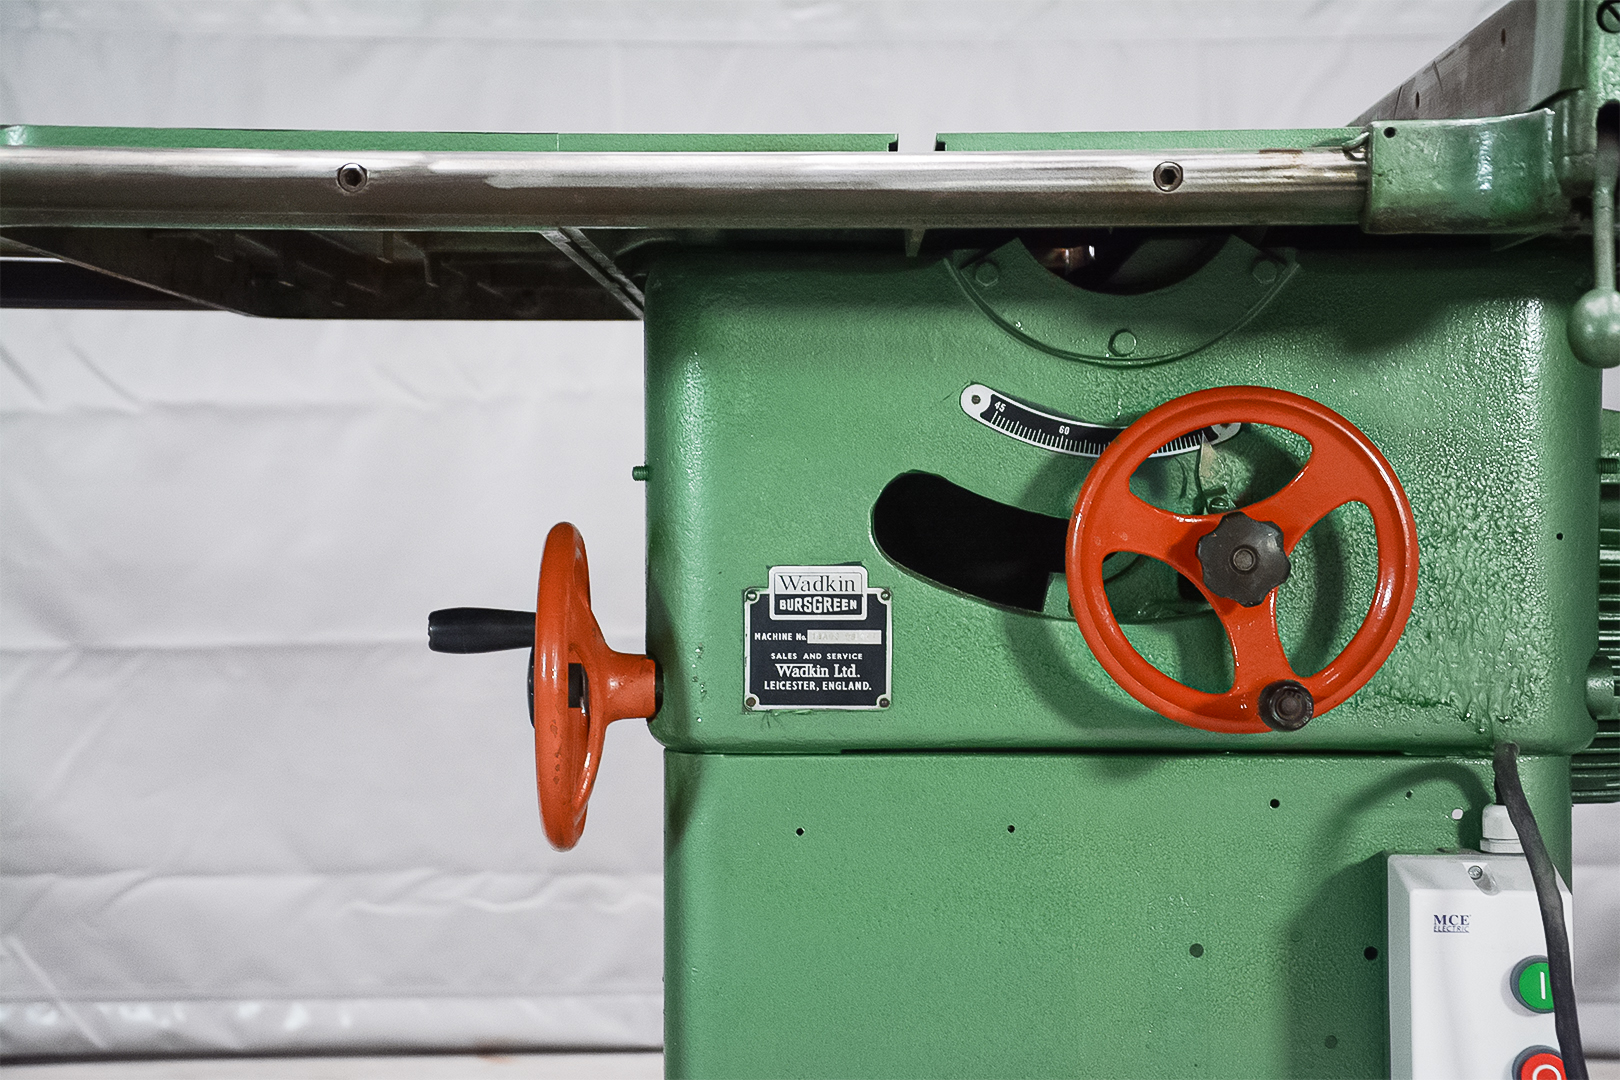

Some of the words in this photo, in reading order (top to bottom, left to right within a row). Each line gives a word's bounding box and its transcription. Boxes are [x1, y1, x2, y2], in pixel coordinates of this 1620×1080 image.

[994, 401, 1007, 413] 45
[1058, 425, 1070, 435] 60
[778, 575, 856, 592] Wadkin
[779, 596, 858, 613] BURSGREEN
[754, 632, 793, 641] MACHINE
[775, 663, 830, 678] Wadkin
[833, 663, 861, 678] Ltd.
[764, 680, 820, 691] LEICESTER,
[822, 680, 872, 691] ENGLAND.
[1433, 914, 1470, 925] MCE
[1433, 925, 1470, 933] ELECTRIC
